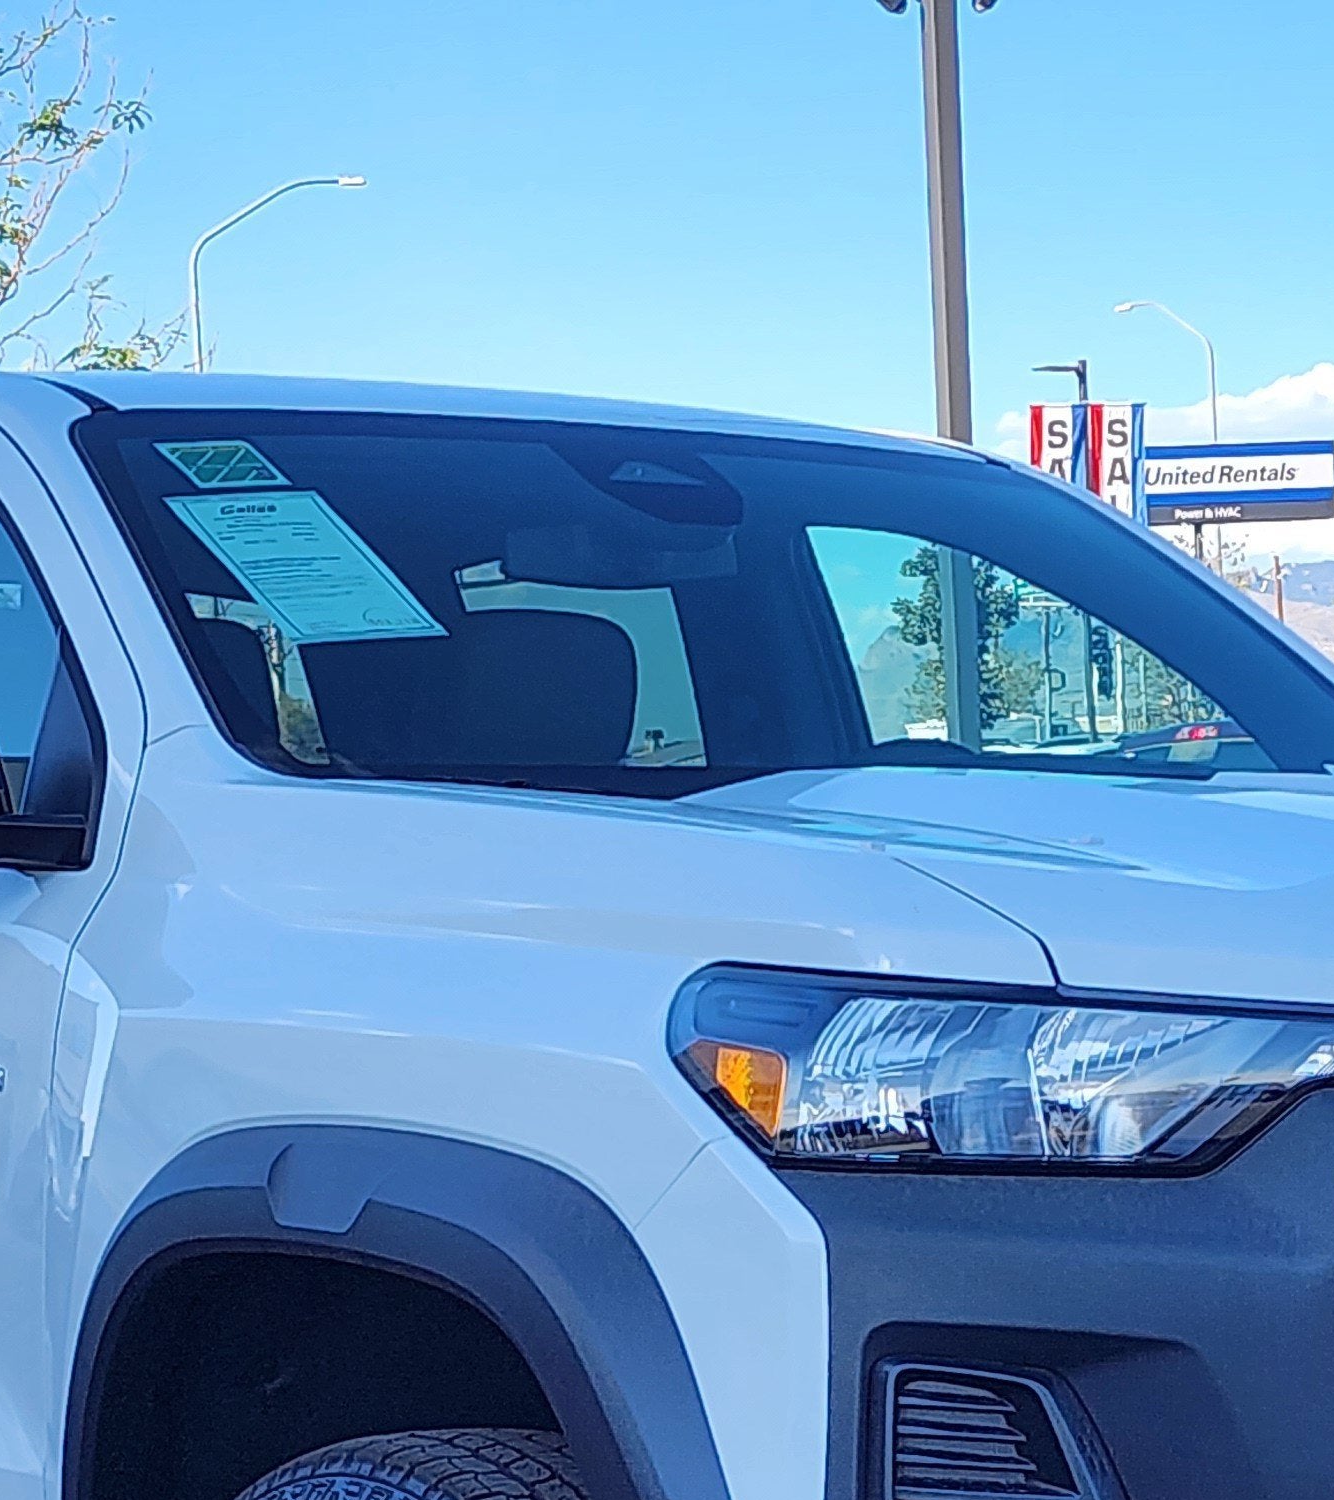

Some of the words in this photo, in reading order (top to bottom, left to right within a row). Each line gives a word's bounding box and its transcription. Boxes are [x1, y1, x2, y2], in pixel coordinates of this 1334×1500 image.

[1144, 465, 1216, 486] United
[1218, 462, 1297, 484] Rentals
[1214, 506, 1242, 518] HVAC
